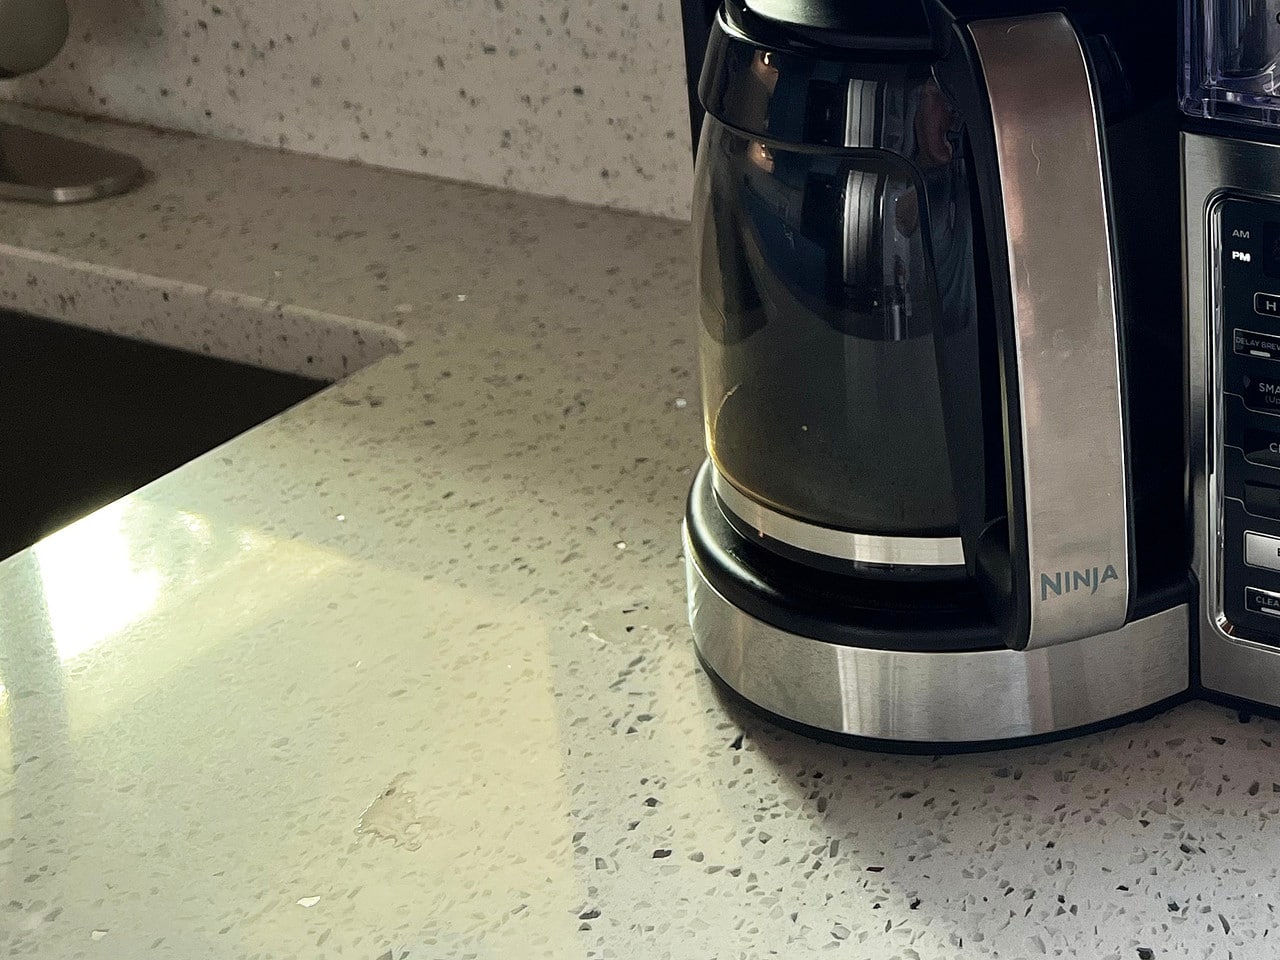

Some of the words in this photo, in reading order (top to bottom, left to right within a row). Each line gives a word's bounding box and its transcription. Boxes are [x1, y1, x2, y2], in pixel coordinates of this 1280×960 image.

[1232, 229, 1250, 239] AM
[1232, 251, 1251, 262] PM
[1266, 301, 1277, 311] H
[1235, 336, 1260, 347] DELAY
[1040, 564, 1119, 601] NINJA
